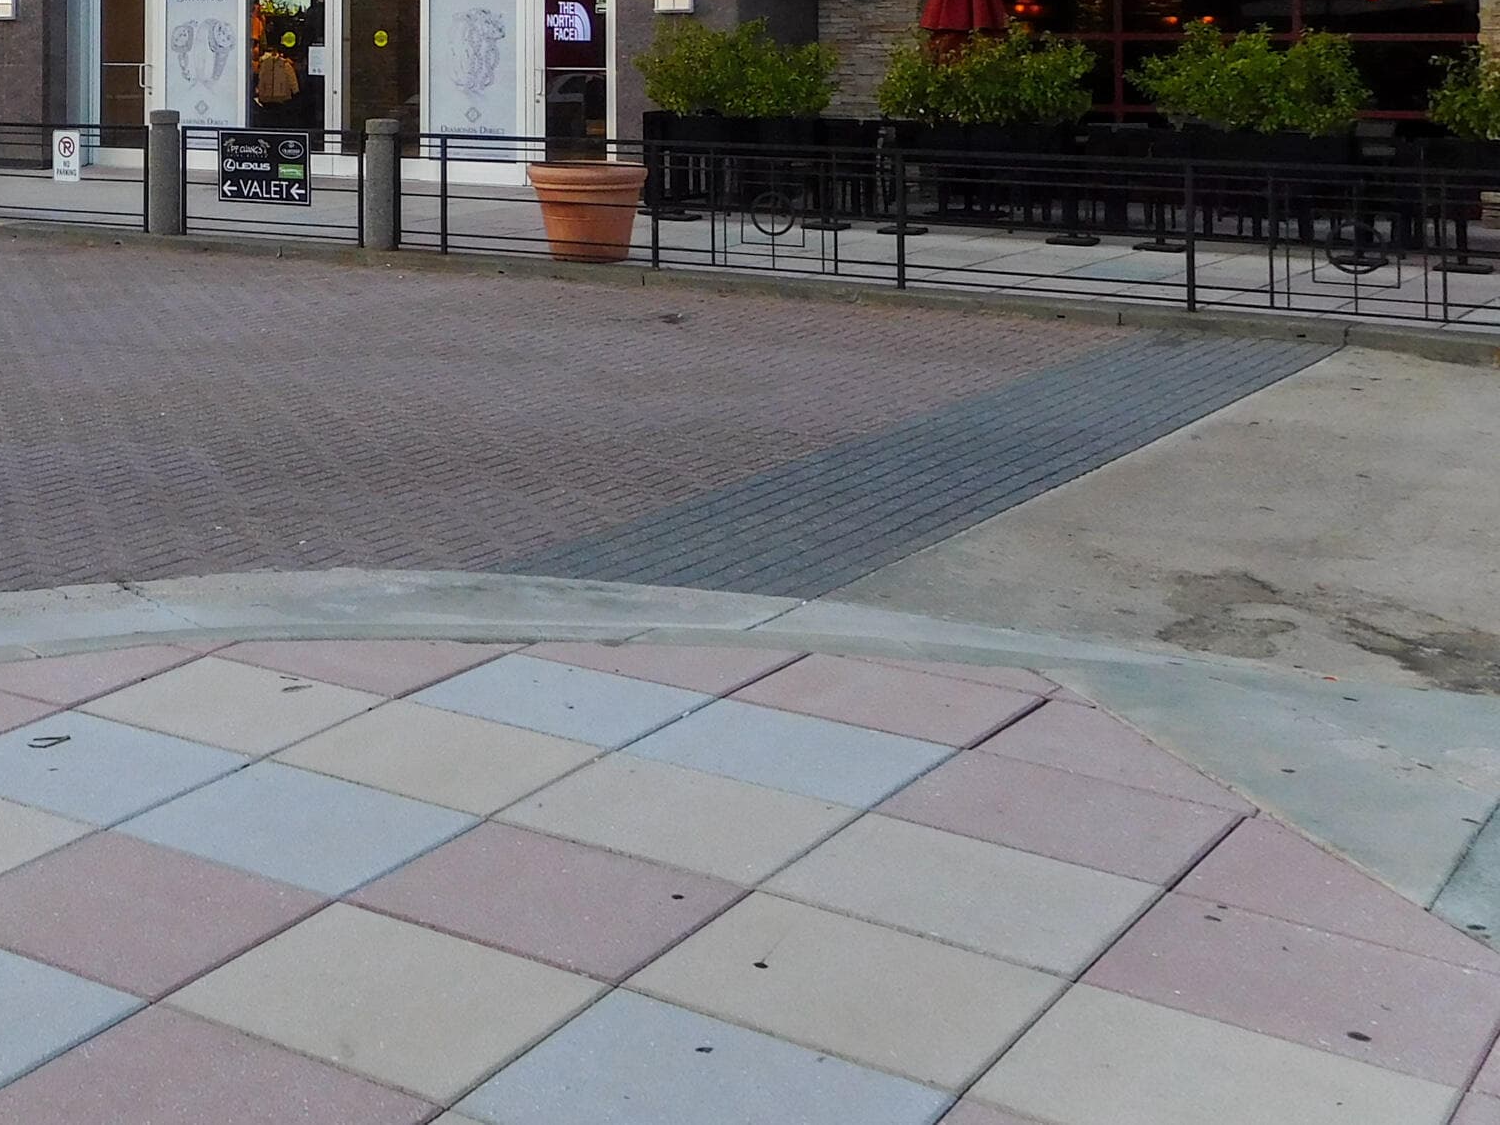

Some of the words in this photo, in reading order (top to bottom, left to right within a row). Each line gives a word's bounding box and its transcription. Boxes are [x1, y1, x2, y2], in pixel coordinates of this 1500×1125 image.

[557, 1, 575, 14] THE
[546, 14, 575, 27] NORTH
[553, 27, 576, 40] FACE
[236, 162, 271, 171] LEXUS
[239, 179, 289, 198] VALET
